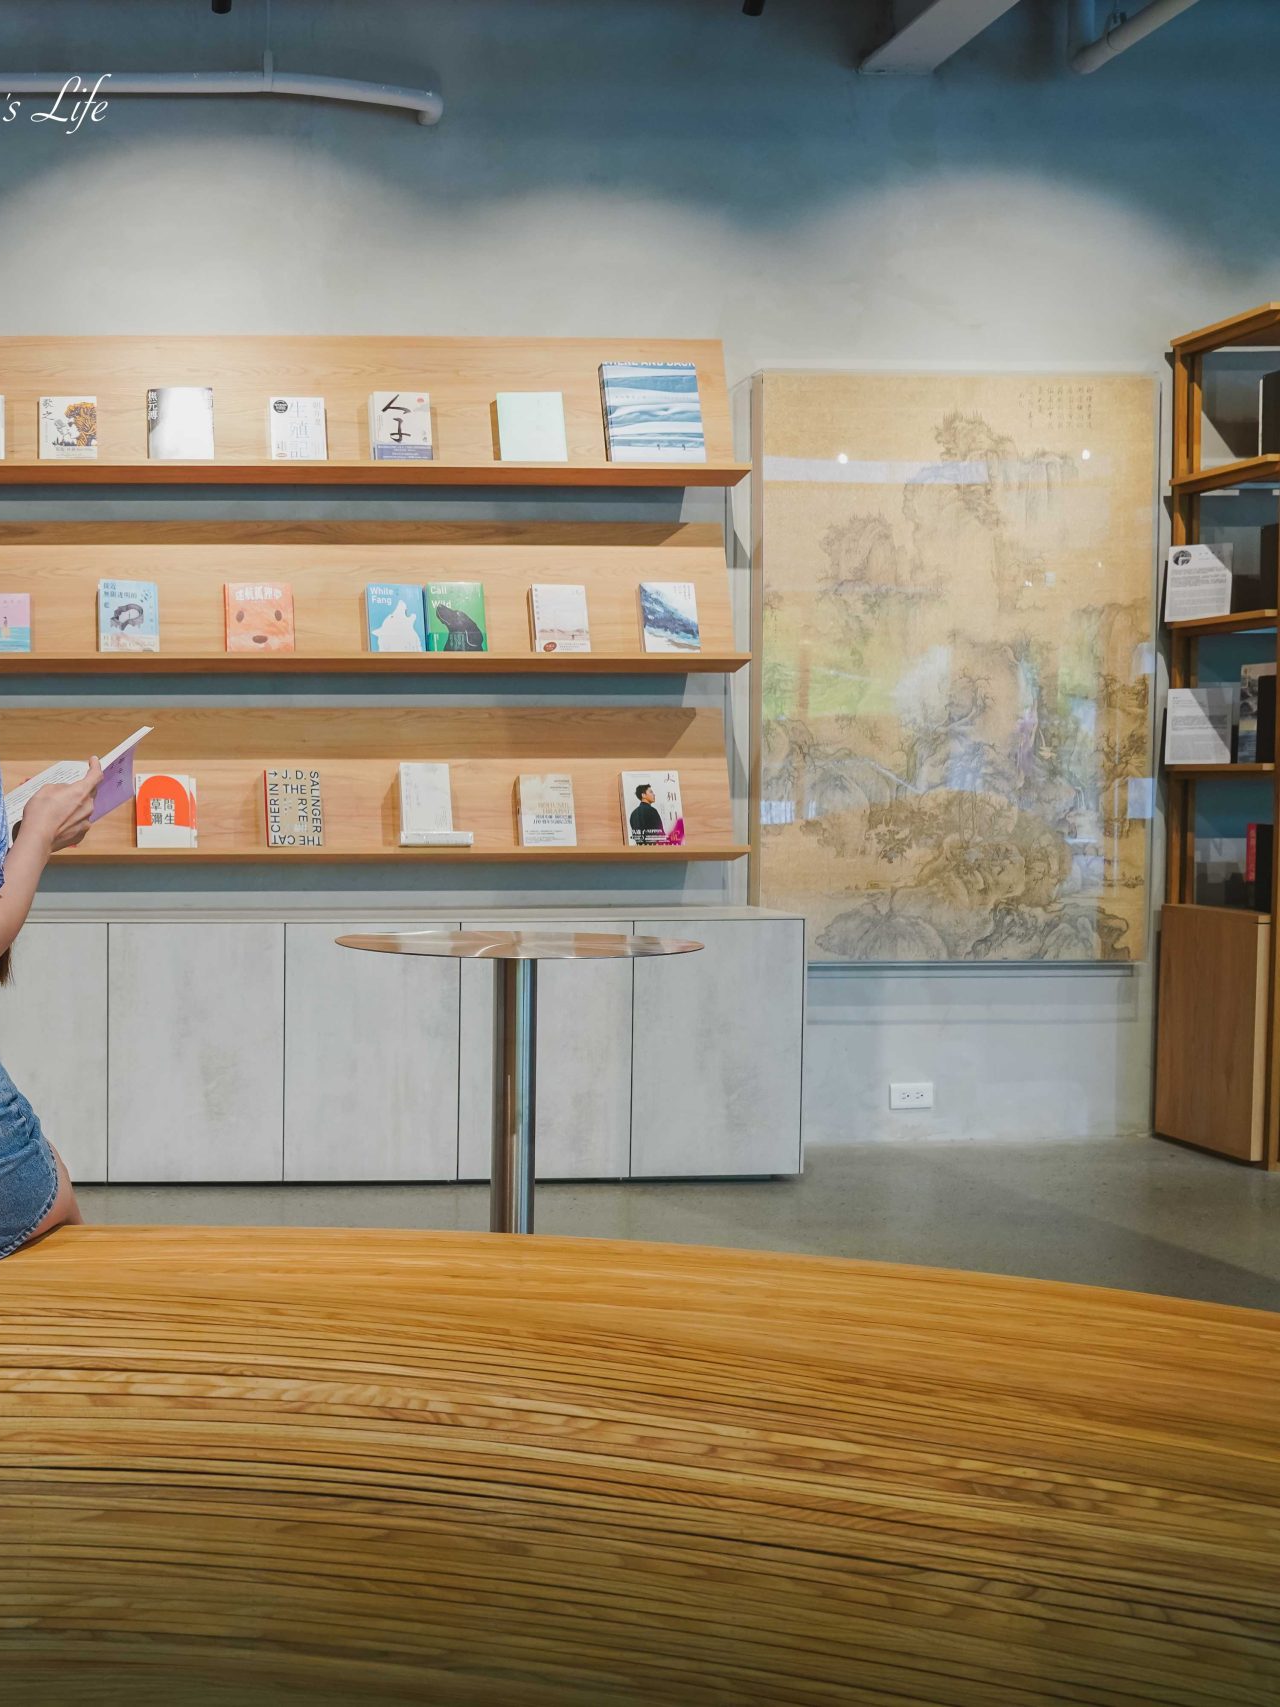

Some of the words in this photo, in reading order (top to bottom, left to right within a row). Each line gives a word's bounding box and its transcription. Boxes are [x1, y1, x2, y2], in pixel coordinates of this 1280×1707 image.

[370, 586, 394, 596] White
[430, 586, 447, 595] Call
[371, 596, 392, 606] Fang
[282, 770, 292, 780] J.
[295, 770, 307, 780] D.
[283, 784, 307, 794] THE
[309, 770, 322, 834] SALINGER
[297, 798, 308, 823] RYE
[300, 836, 322, 846] THE
